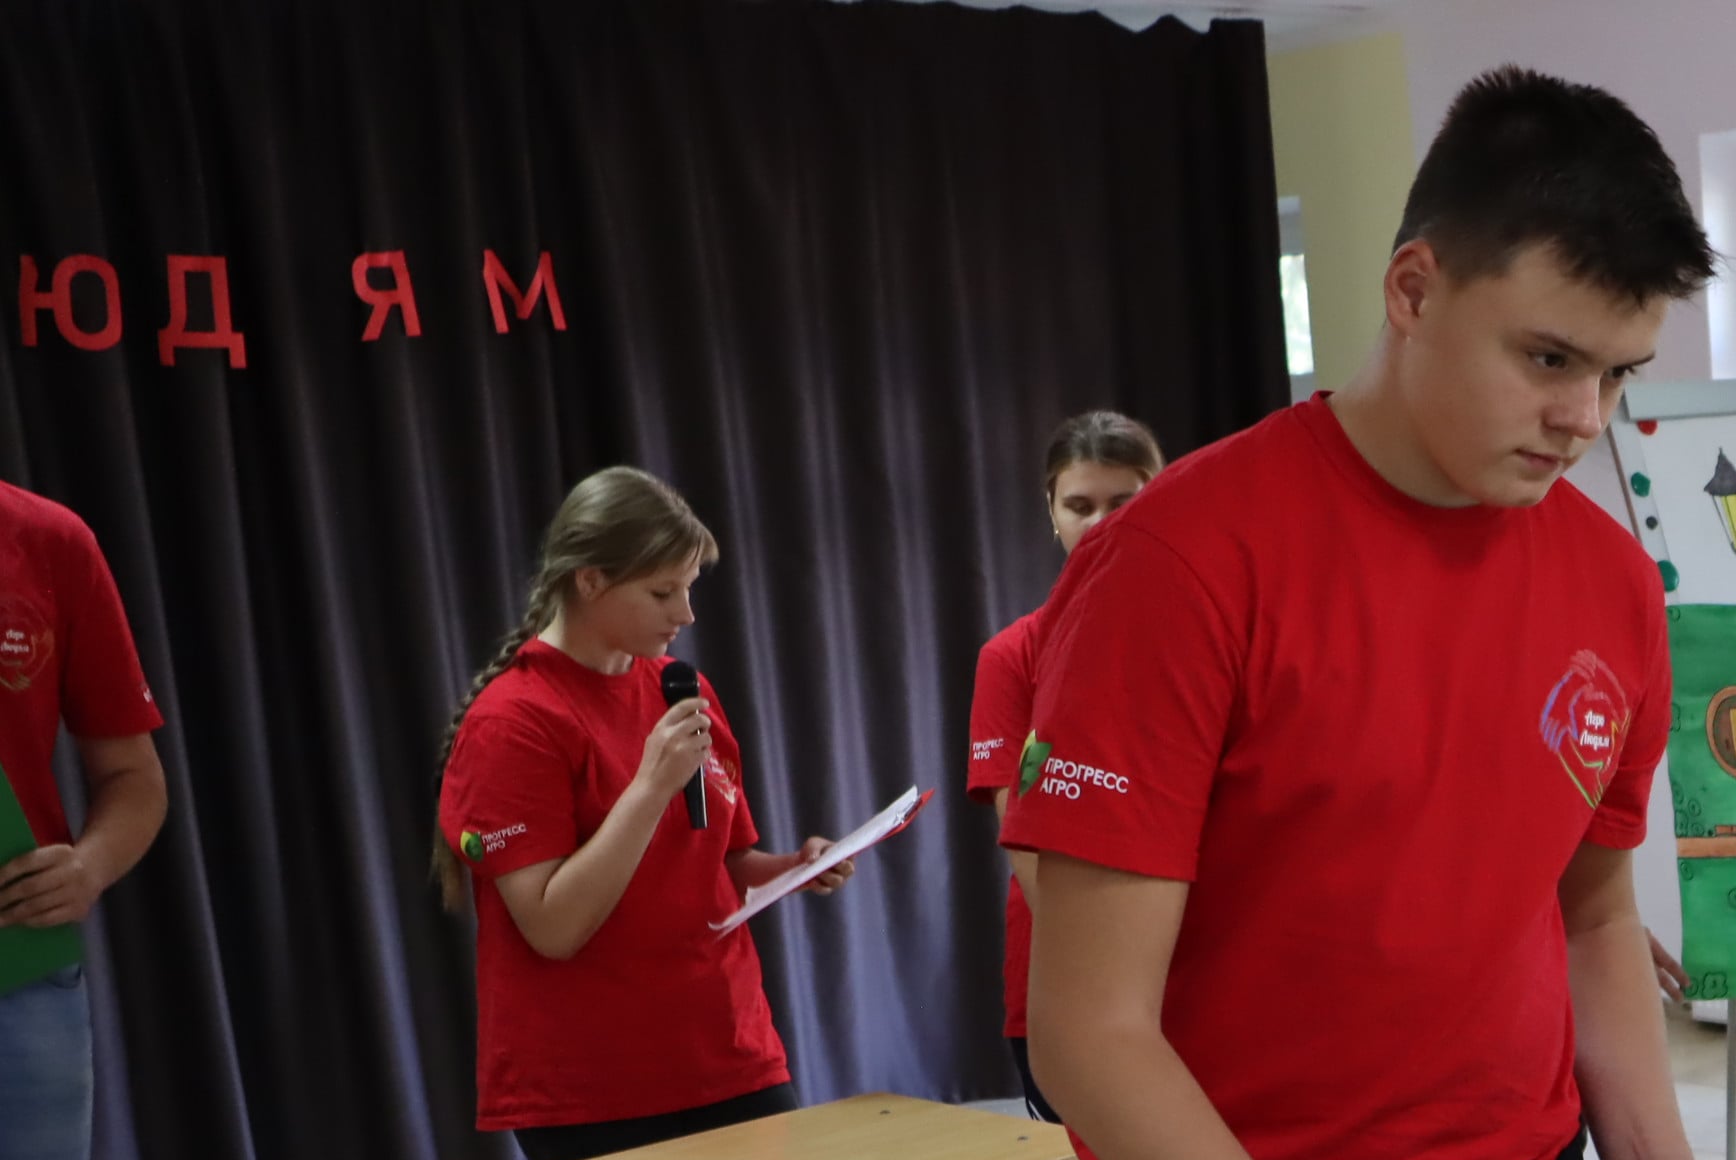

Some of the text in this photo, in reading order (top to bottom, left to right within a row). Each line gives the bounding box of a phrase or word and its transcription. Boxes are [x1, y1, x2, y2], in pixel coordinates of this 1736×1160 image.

[1045, 757, 1129, 794] ПРОГРЕСС
[1041, 777, 1081, 800] АГРО
[481, 823, 527, 844] ПРОГРЕСС
